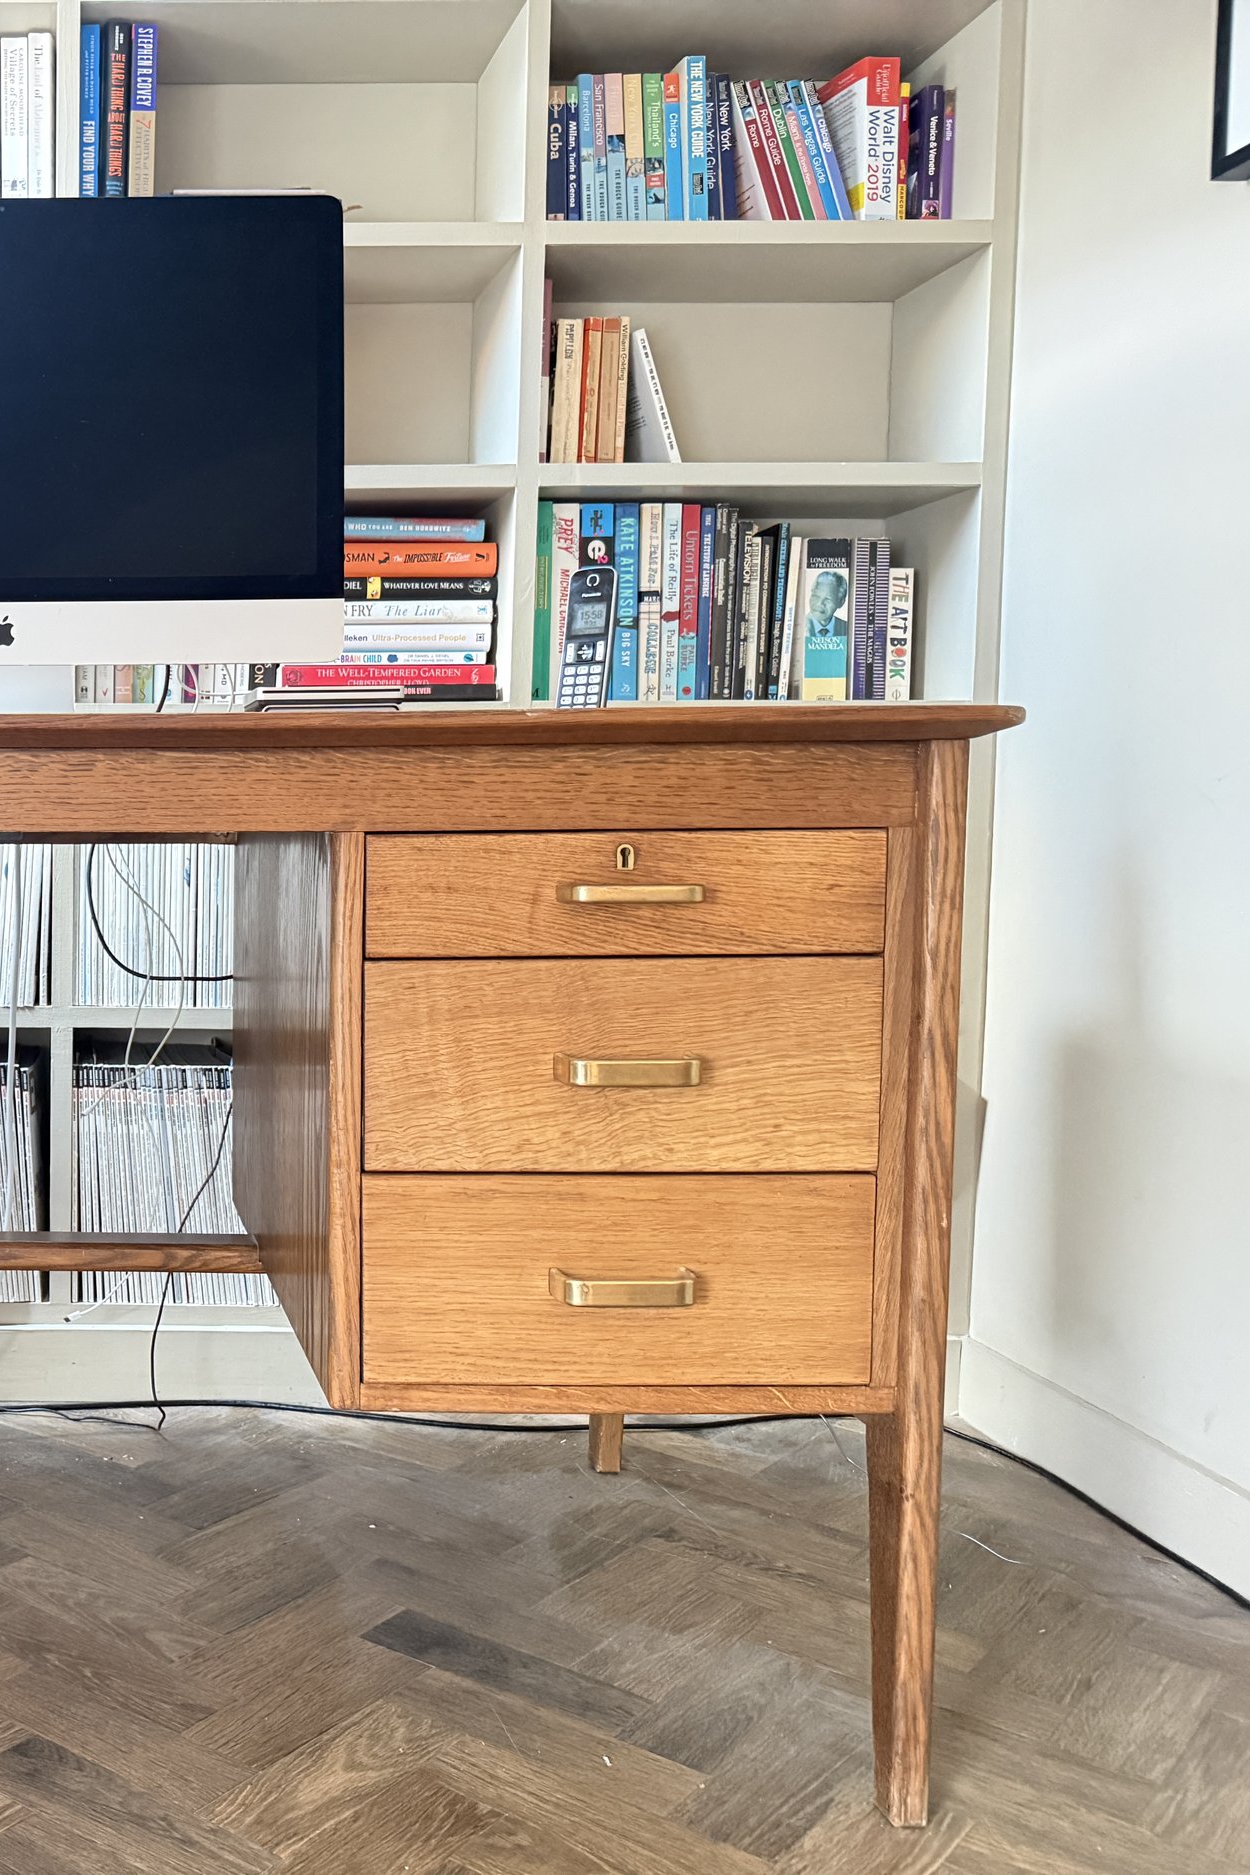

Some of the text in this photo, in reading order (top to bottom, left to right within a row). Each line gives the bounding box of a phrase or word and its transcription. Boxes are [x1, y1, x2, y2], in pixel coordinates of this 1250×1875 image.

[34, 47, 43, 64] The
[137, 28, 153, 66] STEPHEN
[9, 49, 17, 84] Village
[881, 64, 891, 103] Unofficial
[10, 88, 17, 97] of
[34, 89, 43, 99] of
[111, 87, 124, 110] THING
[136, 77, 152, 106] COVEY
[627, 79, 637, 101] New
[582, 90, 591, 131] Barcelona
[595, 84, 604, 145] San Francisco
[629, 105, 639, 128] York
[652, 101, 661, 147] Thailand's
[691, 61, 703, 158] THE NEW YORK GUIDE
[719, 101, 731, 151] New York
[773, 108, 788, 138] Dublin
[83, 121, 95, 143] FIND
[550, 123, 562, 159] Cuba
[568, 121, 577, 150] Milan,
[668, 113, 678, 148] Chicago
[706, 130, 715, 154] York
[748, 124, 760, 148] Rome
[759, 108, 782, 166] Rome Guide
[817, 118, 832, 153] Chicago
[929, 116, 938, 141] Venice
[82, 146, 94, 171] YOUR
[109, 148, 122, 177] THINGS
[798, 109, 826, 184] Las Vegas Guide
[880, 109, 895, 203] Walt Disney
[928, 149, 937, 176] Veneto
[82, 174, 94, 197] WHY
[706, 157, 716, 190] Guide
[867, 164, 879, 202] 2019
[619, 353, 627, 381] Golding
[558, 517, 574, 554] PREY
[404, 553, 443, 563] IMPOSSIBLE
[619, 518, 634, 626] KATE ATKINSON
[743, 530, 753, 584] TELEVISION
[762, 544, 770, 582] INTRODUCTION
[559, 569, 570, 608] MICHAEL
[683, 530, 697, 620] Untorn Tickets
[351, 605, 442, 616] FRY The Liar
[665, 521, 678, 678] The Life of Reilly Paul Burke
[438, 634, 467, 642] People
[889, 572, 909, 680] THE ART BOOK
[363, 655, 382, 663] CHILD
[621, 632, 630, 667] BIG SKY
[316, 668, 461, 677] THE WELL-TEMPERED GARDEN
